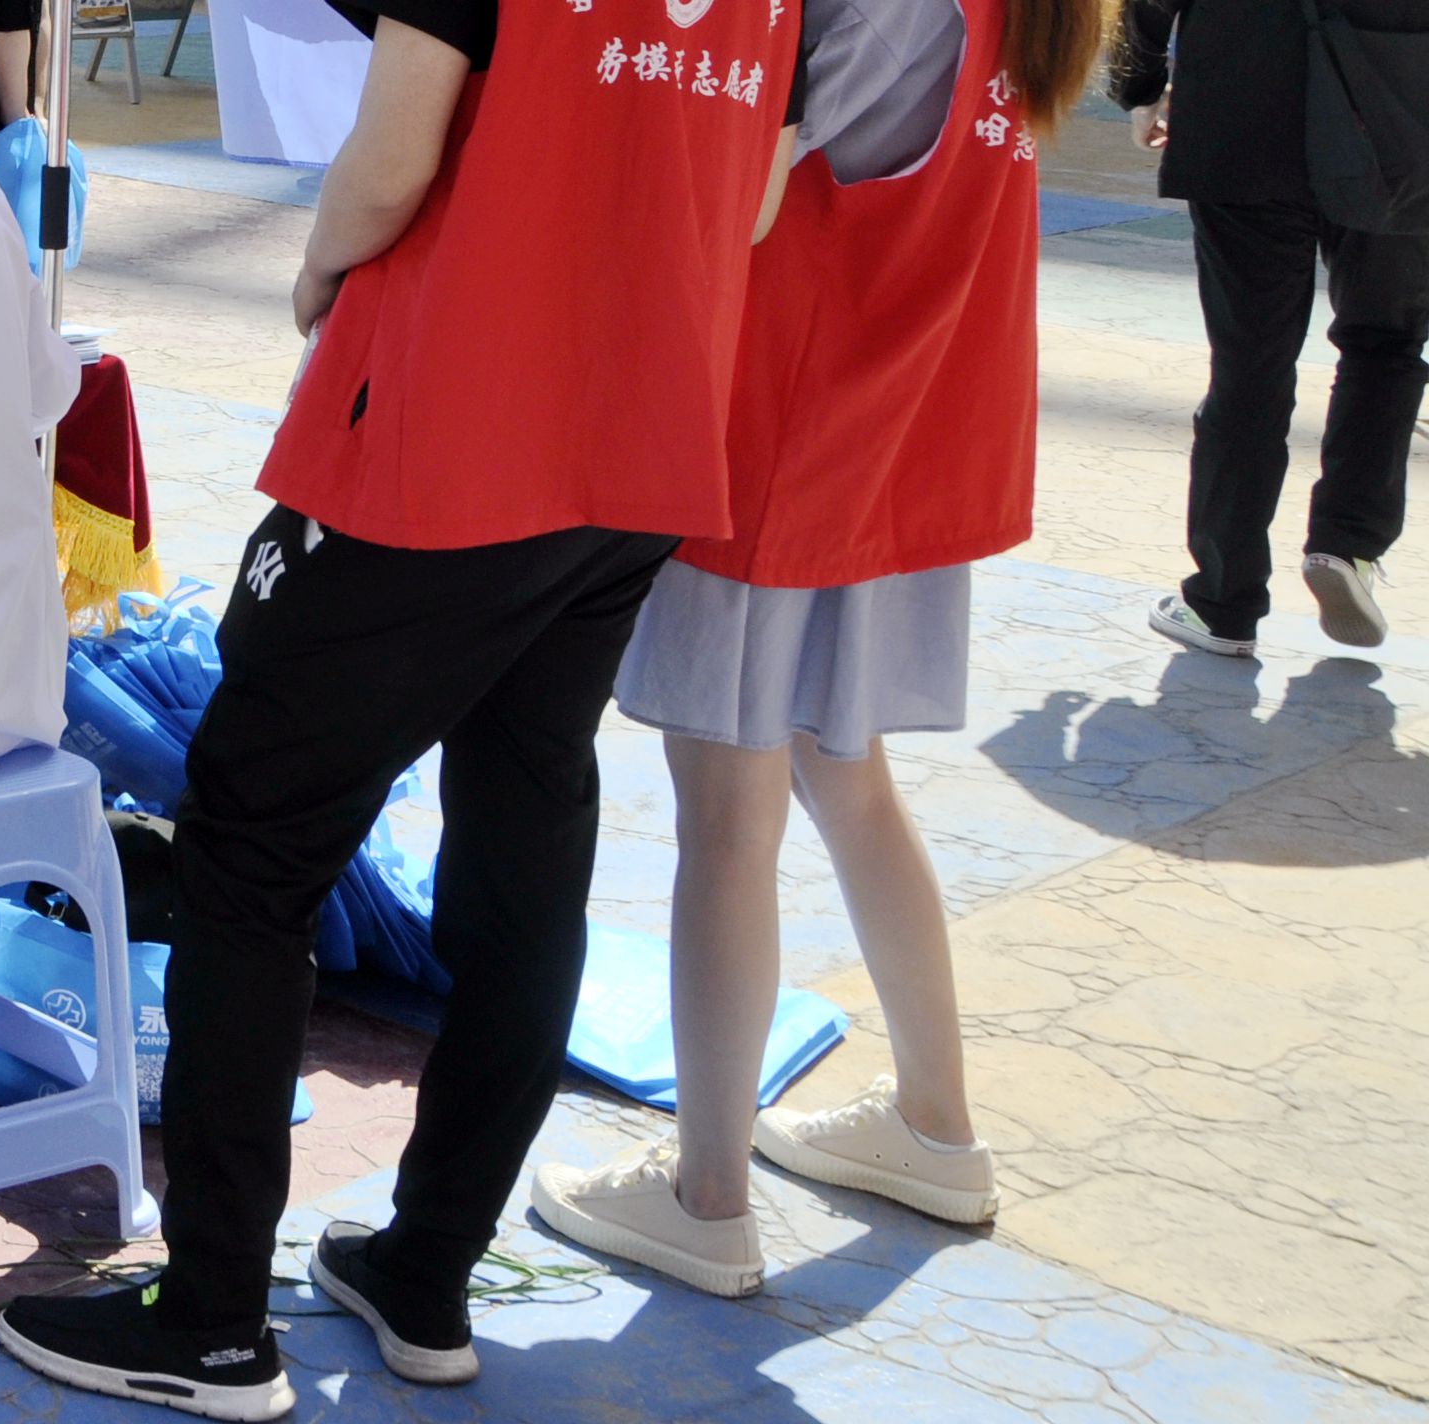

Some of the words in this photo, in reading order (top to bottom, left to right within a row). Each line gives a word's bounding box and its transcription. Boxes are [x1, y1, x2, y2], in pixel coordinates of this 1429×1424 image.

[596, 37, 765, 108] 劳模志愿者
